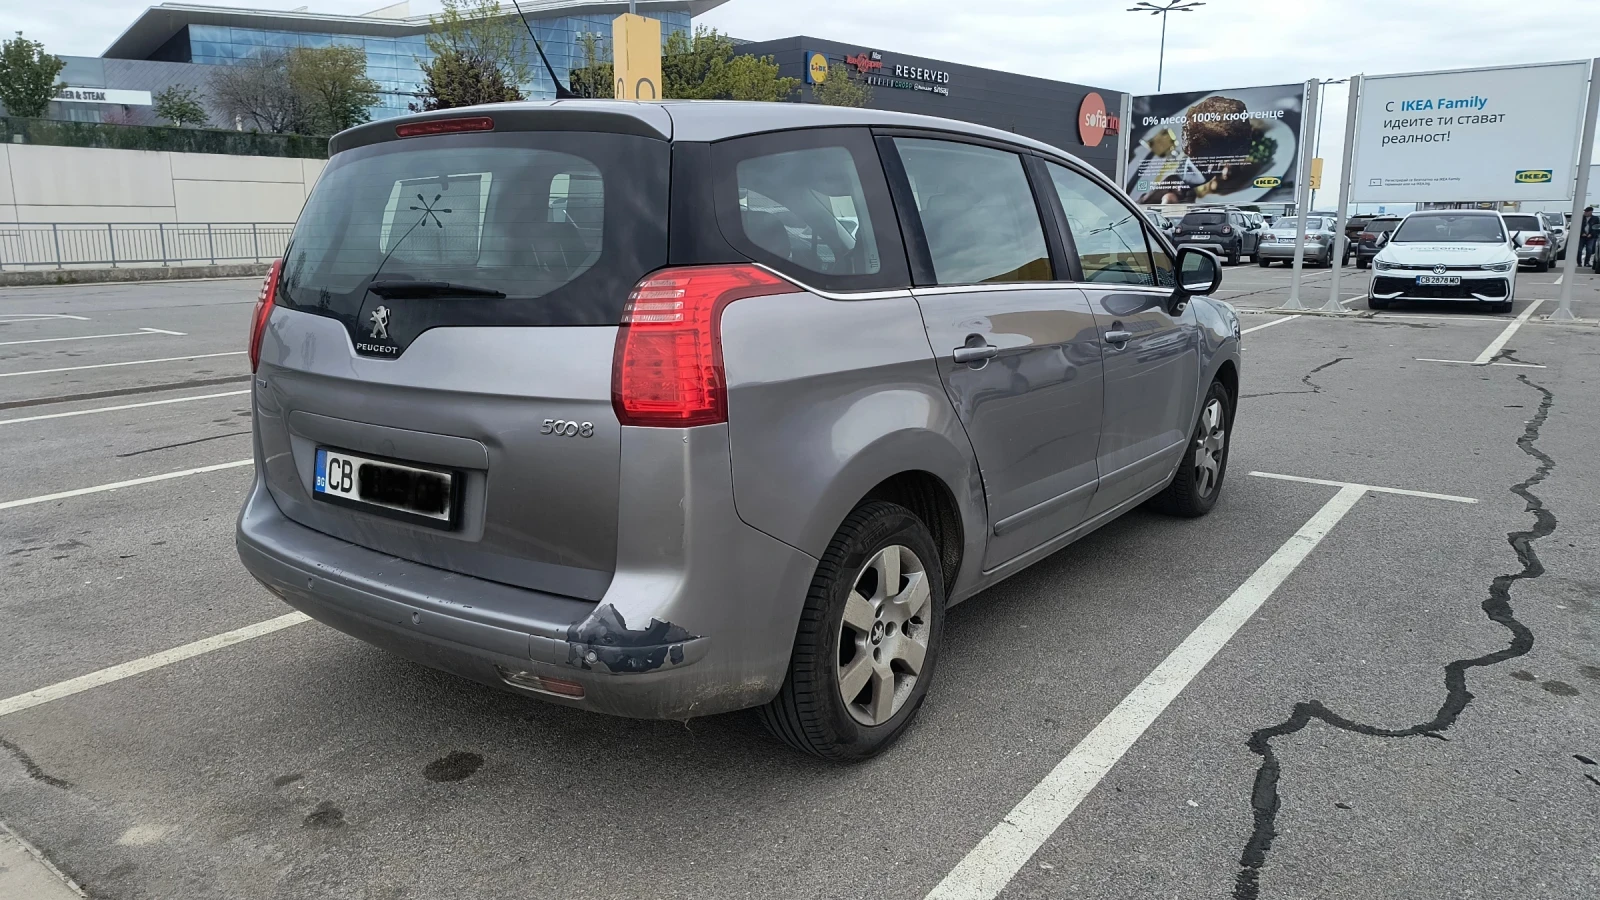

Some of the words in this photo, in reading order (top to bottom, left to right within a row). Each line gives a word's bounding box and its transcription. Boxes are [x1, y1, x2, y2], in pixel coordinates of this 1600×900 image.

[895, 64, 950, 84] RESERVED
[82, 91, 106, 101] STEAK
[1401, 99, 1434, 112] IKEA
[1437, 96, 1488, 111] Family
[1142, 115, 1159, 126] 0%
[1160, 114, 1190, 126] месо,
[1192, 112, 1221, 123] 100%
[1223, 109, 1285, 123] кюфтенце
[1383, 117, 1434, 130] идеите
[1437, 116, 1454, 126] ти
[1457, 112, 1506, 125] стават
[1381, 131, 1451, 147] реалност!
[1420, 276, 1430, 284] CB
[1431, 276, 1449, 284] 2878
[356, 342, 398, 354] PEUGEOT
[540, 418, 594, 438] 5008
[316, 476, 326, 487] BG
[328, 457, 353, 493] CB
